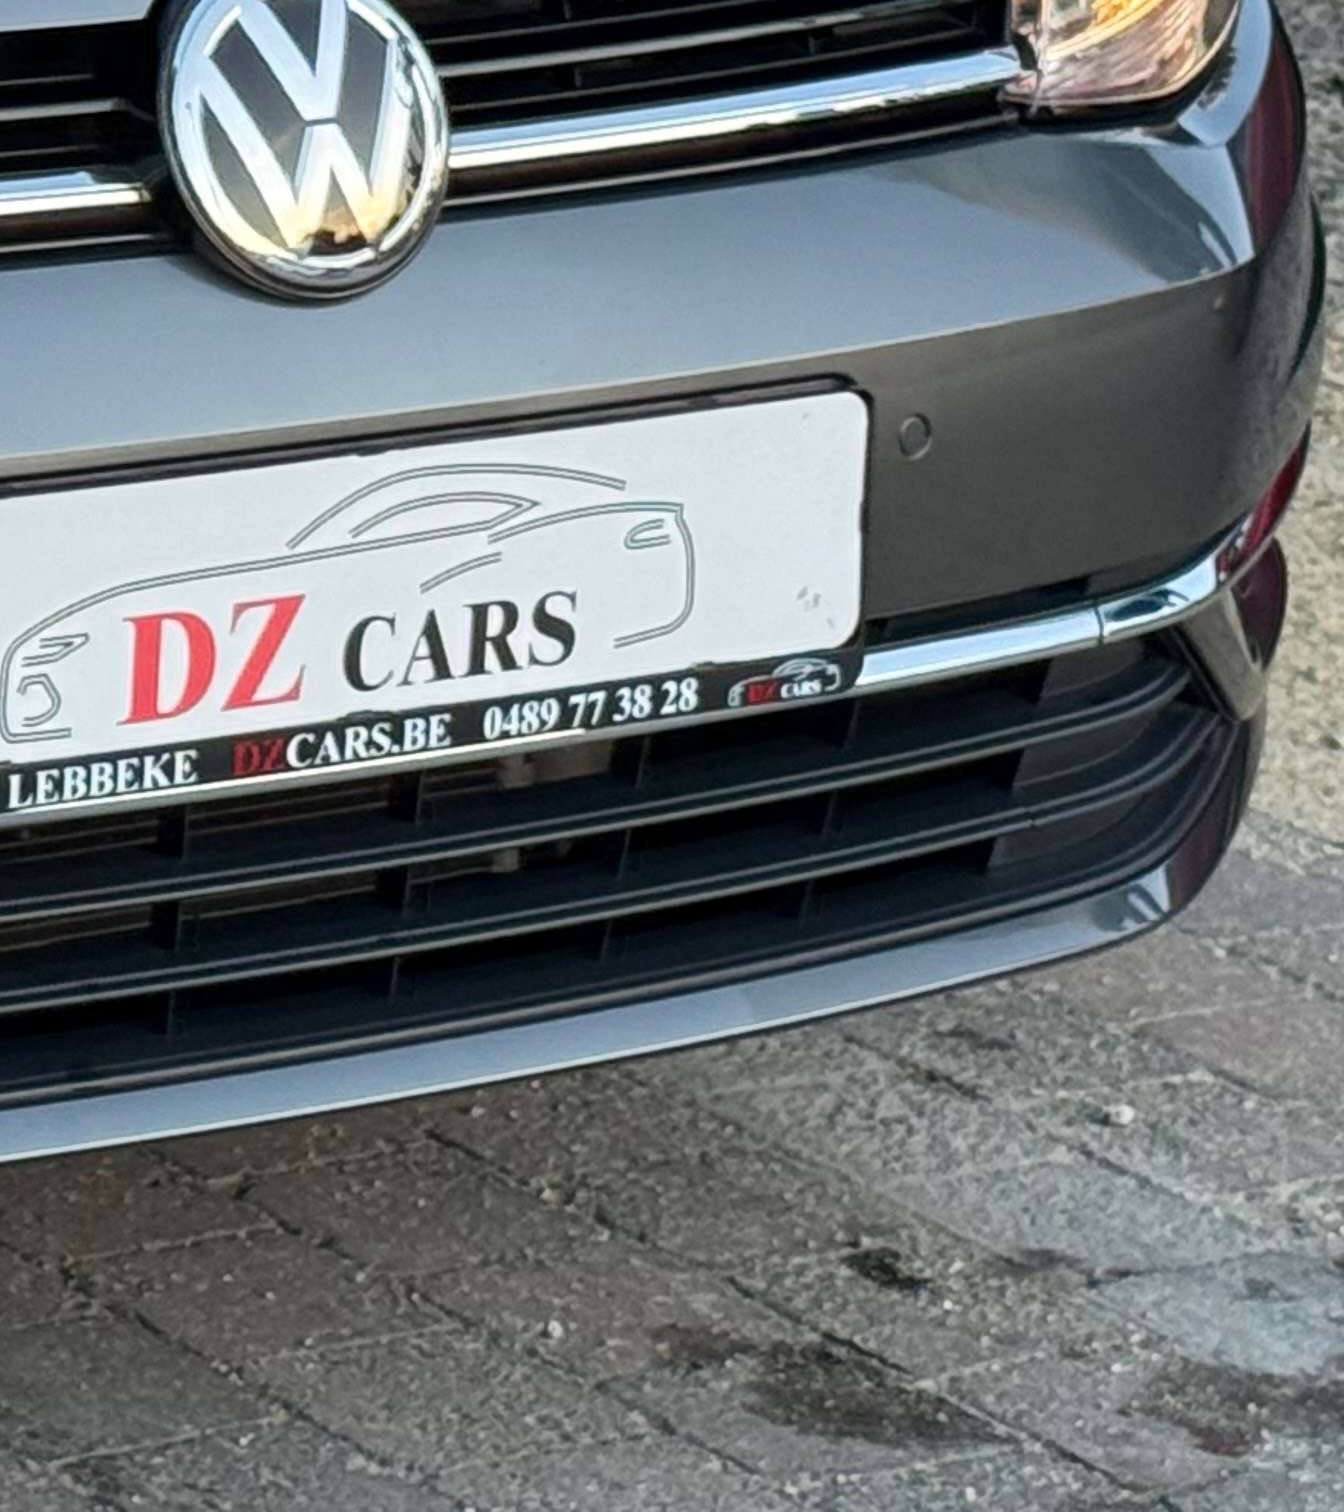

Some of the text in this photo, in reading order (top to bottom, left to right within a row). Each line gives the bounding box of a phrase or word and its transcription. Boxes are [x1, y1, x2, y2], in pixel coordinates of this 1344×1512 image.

[115, 590, 578, 727] DZ CARS
[7, 676, 700, 809] LEBBEKE DZCARS.BE 0489 77 38 28
